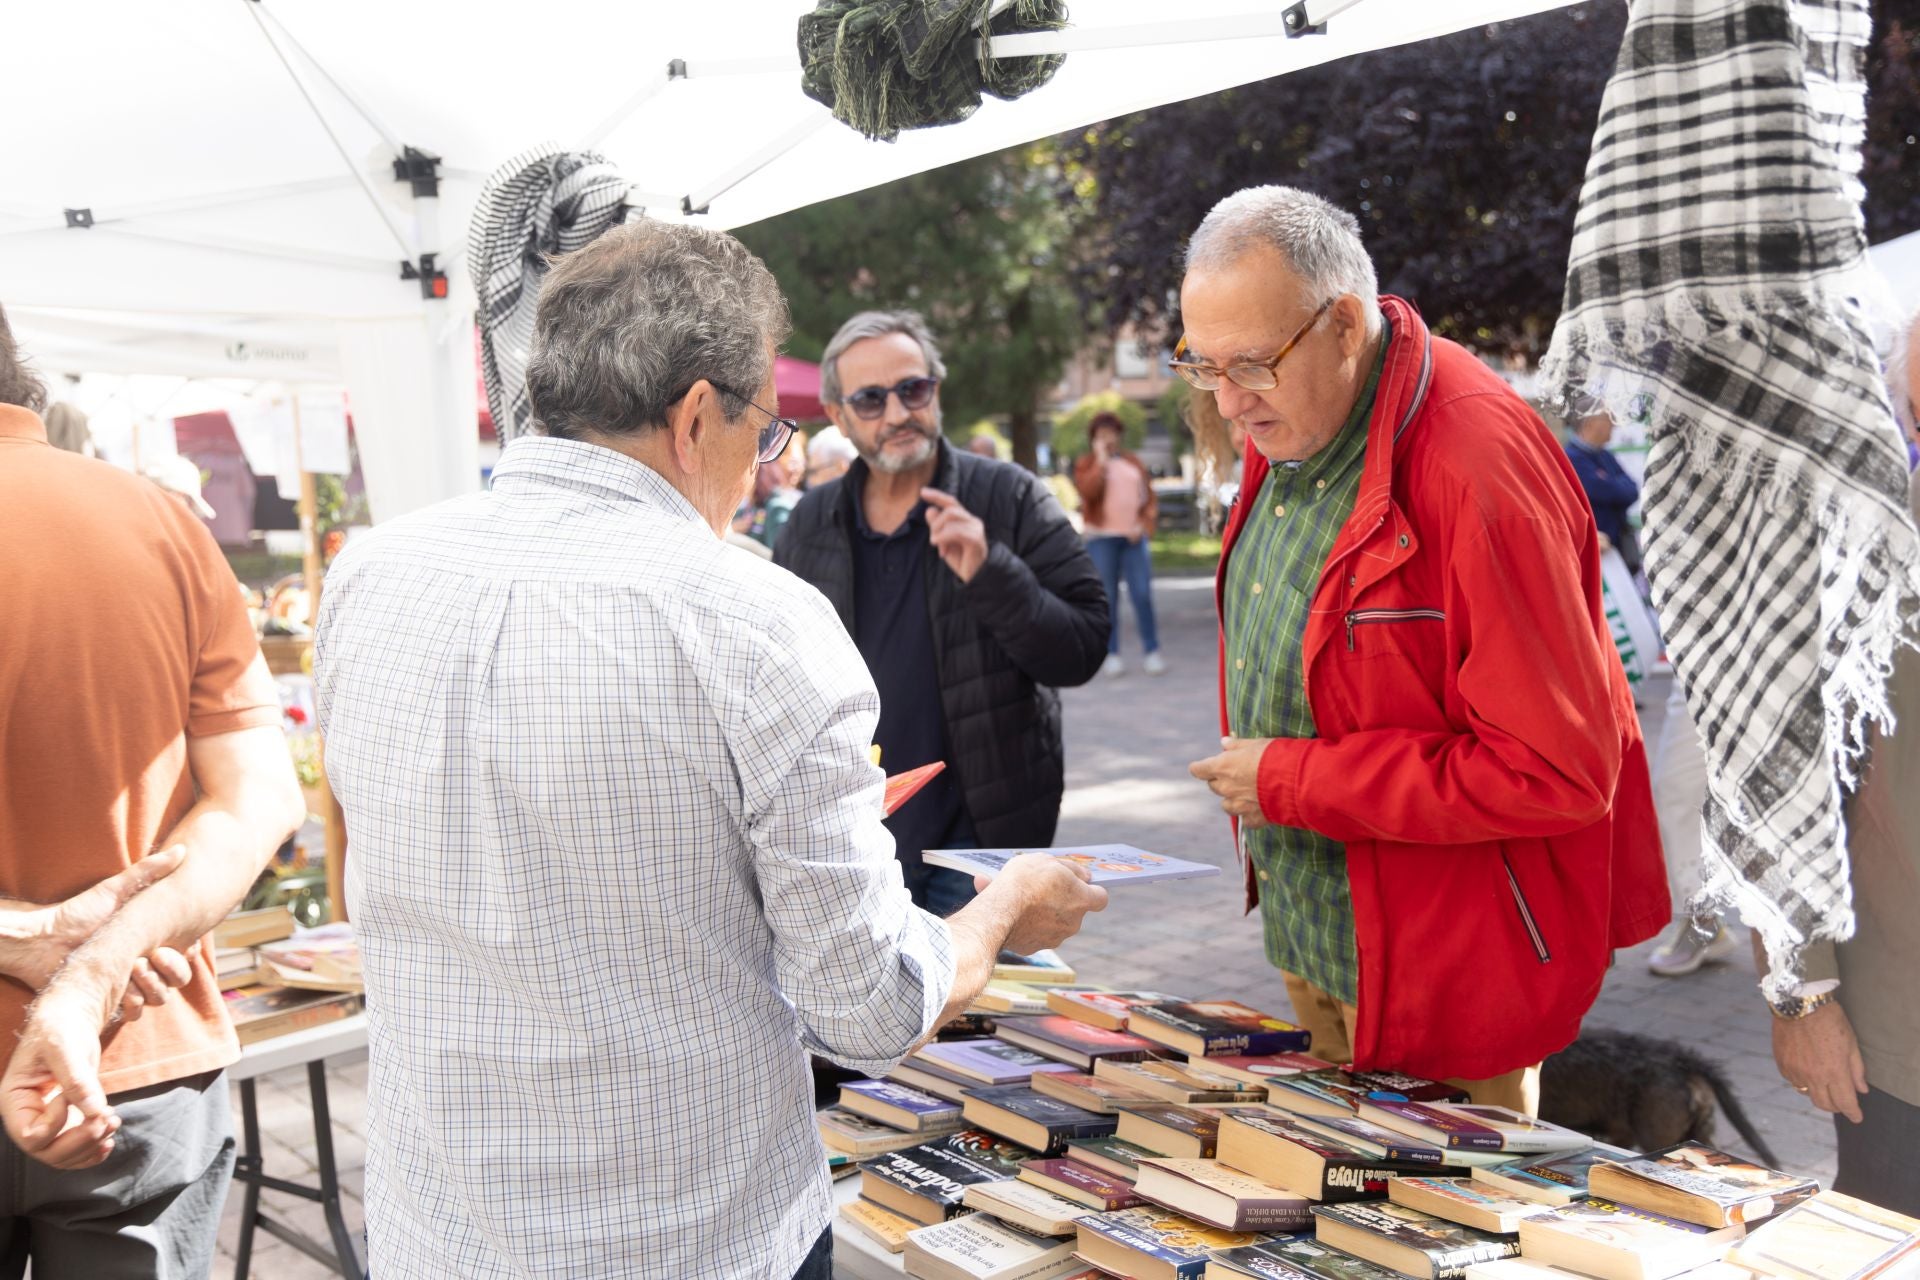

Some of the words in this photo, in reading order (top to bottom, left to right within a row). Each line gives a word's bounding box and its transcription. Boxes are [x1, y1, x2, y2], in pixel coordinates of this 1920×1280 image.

[1327, 1166, 1364, 1192] Troya
[1365, 1170, 1373, 1180] de
[955, 1224, 979, 1236] cosas
[1439, 1269, 1453, 1279] Lera
[1453, 1268, 1461, 1276] de
